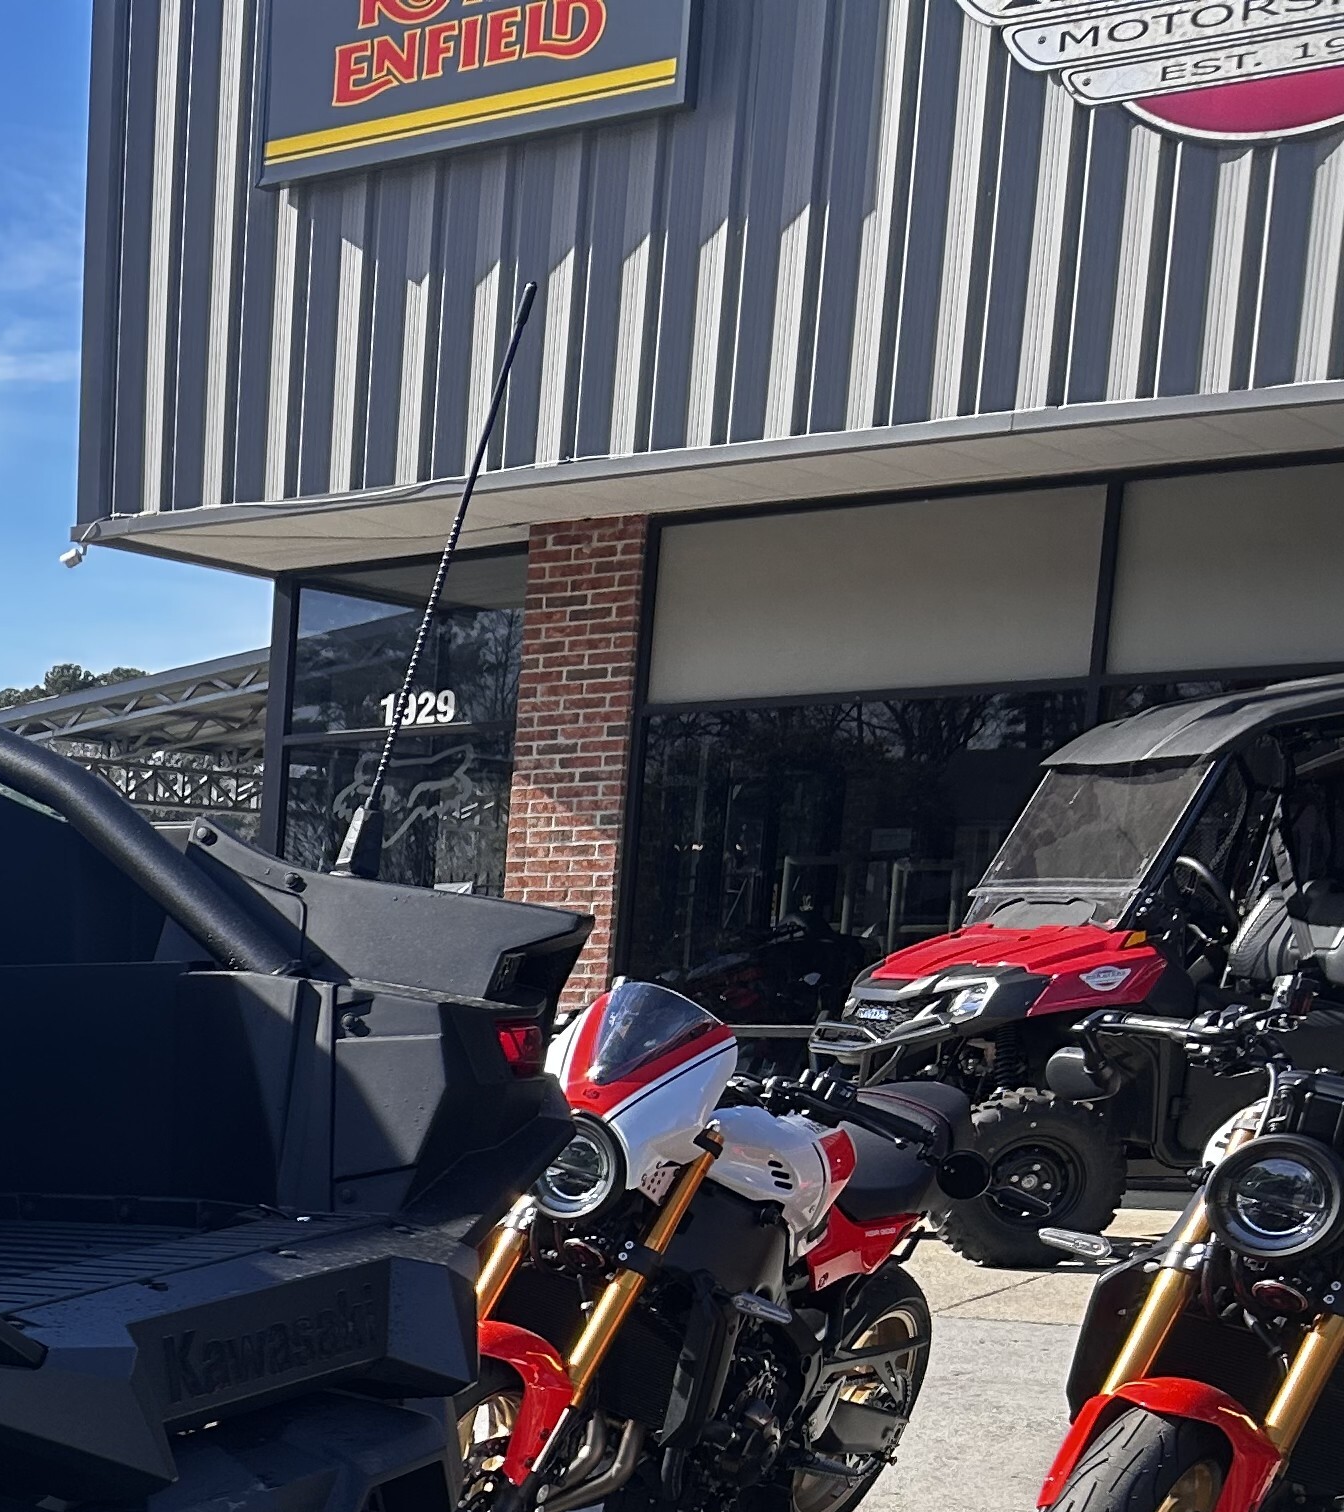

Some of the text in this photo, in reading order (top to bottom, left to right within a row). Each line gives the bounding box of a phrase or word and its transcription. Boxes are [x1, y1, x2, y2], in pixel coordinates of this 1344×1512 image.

[332, 0, 607, 106] ENFIELD
[1058, 0, 1344, 53] MOTOR
[1160, 50, 1263, 83] EST.
[161, 1281, 378, 1404] Kawasaki
